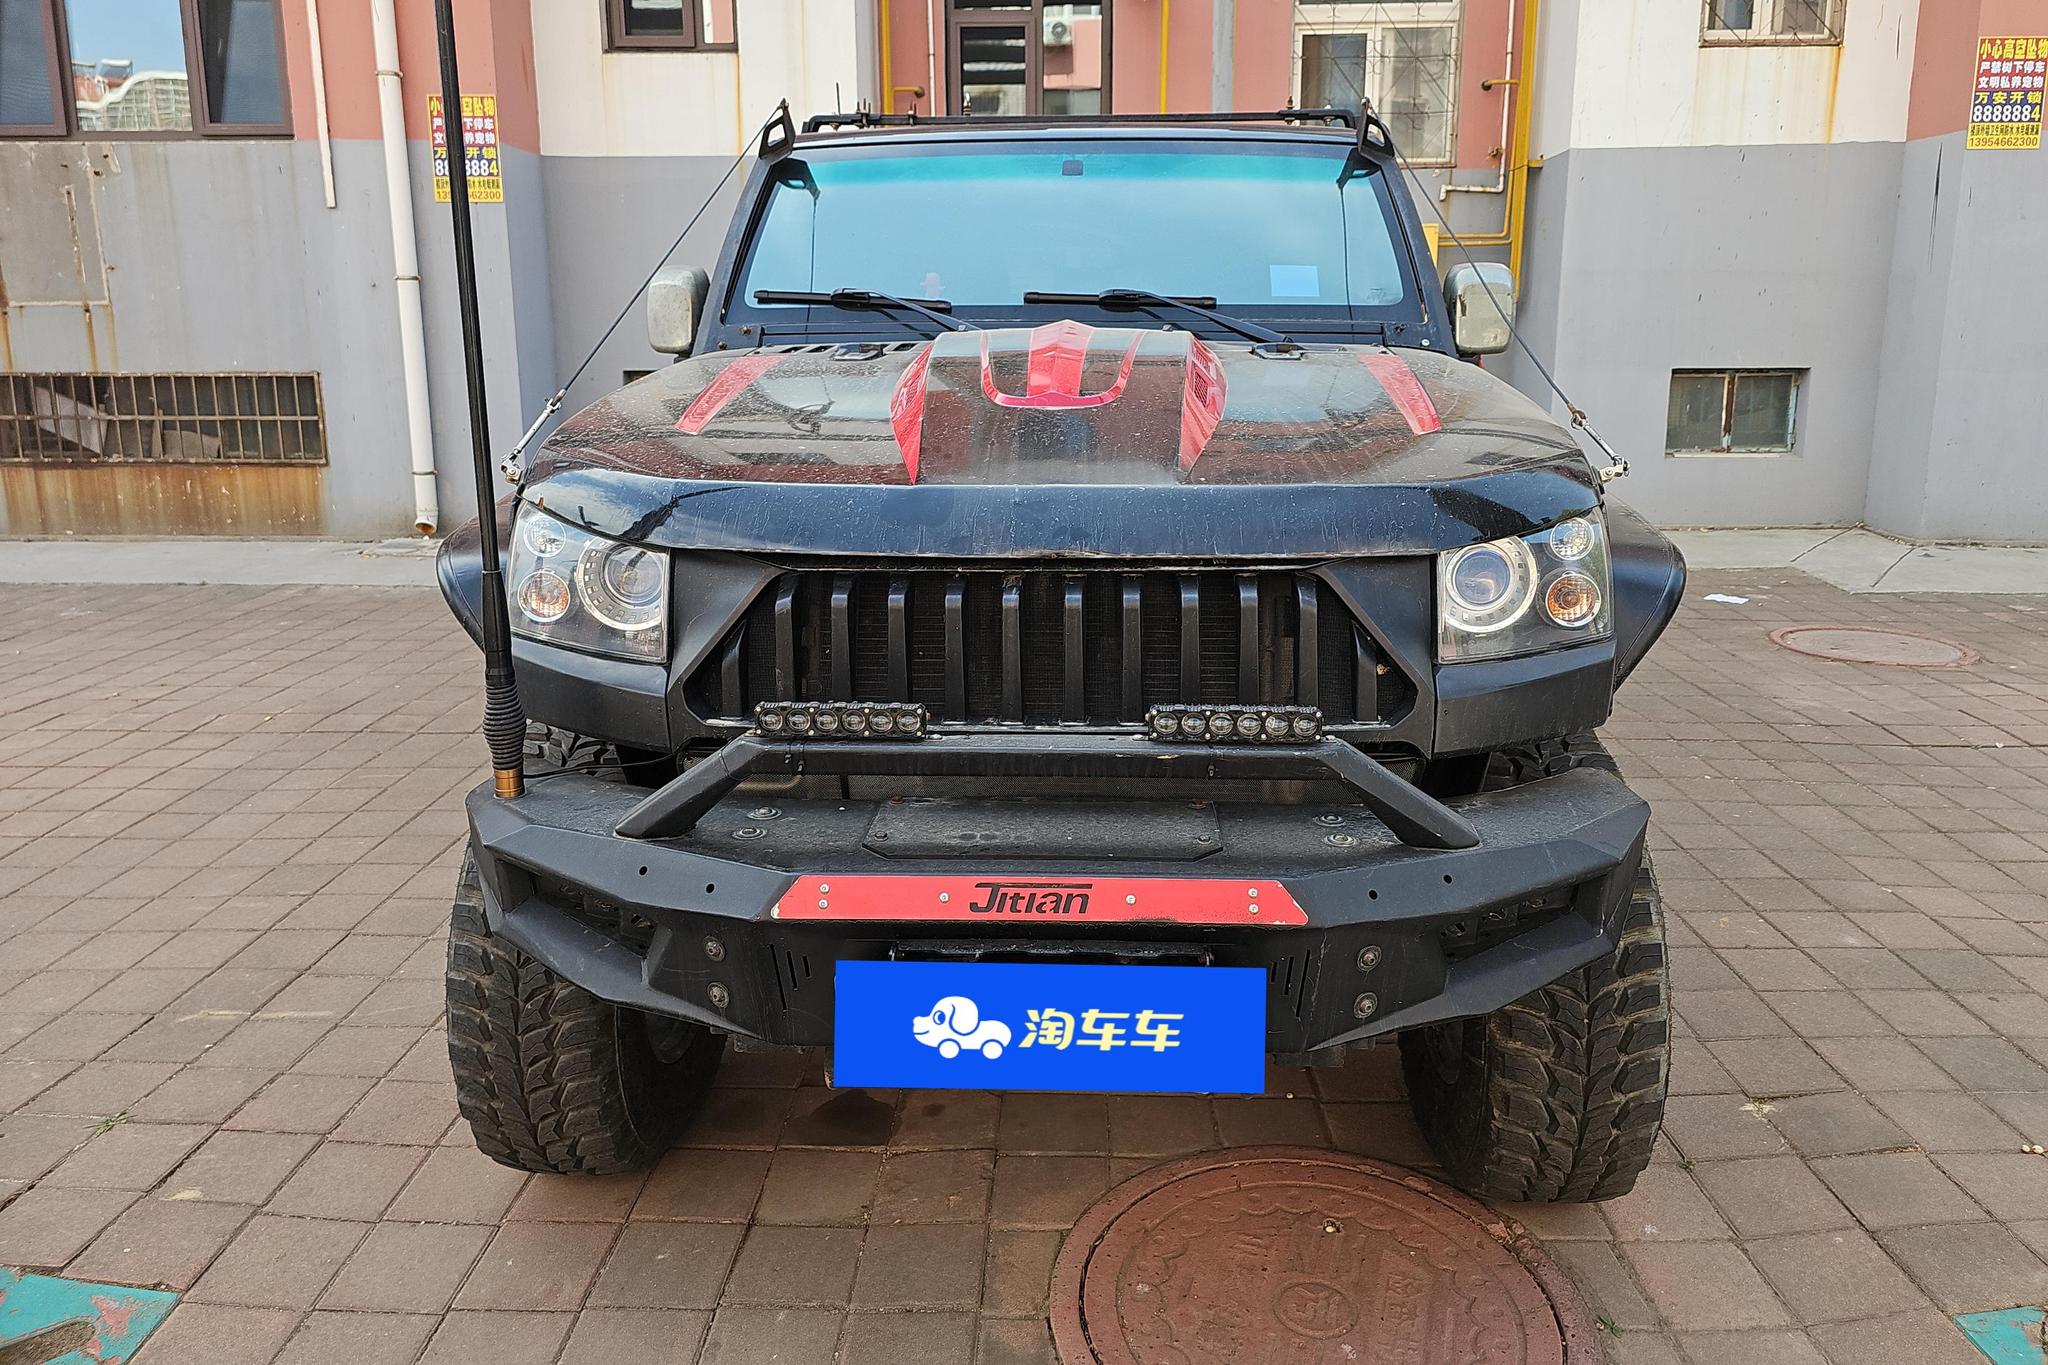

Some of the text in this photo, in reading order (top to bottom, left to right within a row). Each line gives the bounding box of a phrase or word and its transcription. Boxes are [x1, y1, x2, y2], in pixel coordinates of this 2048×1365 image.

[1980, 38, 2048, 59] 小心高空坠物
[1980, 61, 2045, 73] 严禁树下停车
[1978, 76, 2044, 88] 文明私养宠物
[1975, 92, 2042, 104] 万安开锁
[430, 97, 495, 116] 小空坠物
[1973, 105, 2040, 122] 8888884
[433, 118, 494, 130] 严下停车
[433, 132, 495, 145] 文养宠物
[1969, 137, 2038, 147] 13954662300
[434, 147, 497, 159] 万开锁
[969, 882, 1093, 914] Jitian
